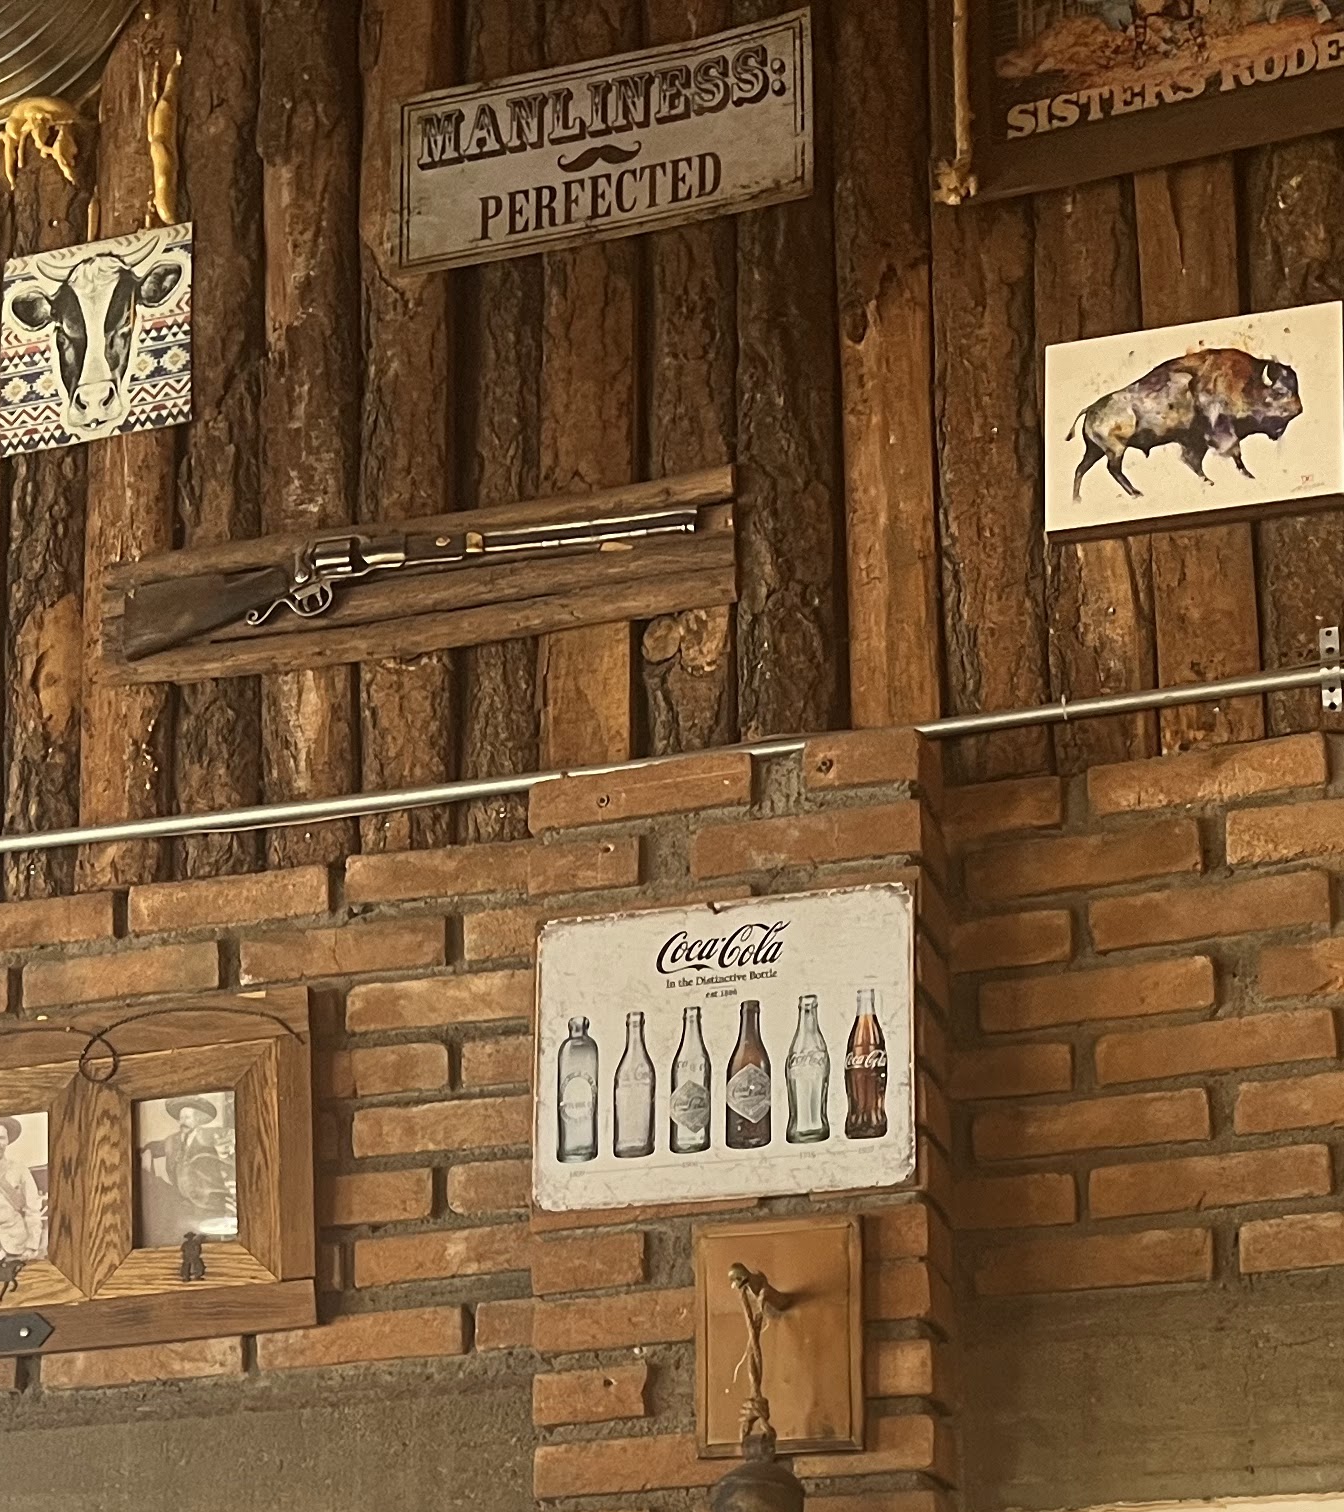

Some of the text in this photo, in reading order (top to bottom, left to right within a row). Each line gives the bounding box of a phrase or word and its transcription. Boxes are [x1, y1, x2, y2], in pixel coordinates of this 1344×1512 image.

[416, 43, 786, 171] MANLINESS:
[1006, 77, 1207, 140] SISTERS
[478, 150, 722, 241] PERFECTED
[655, 920, 792, 974] Coca-Cola
[666, 979, 676, 988] In
[678, 977, 694, 987] the
